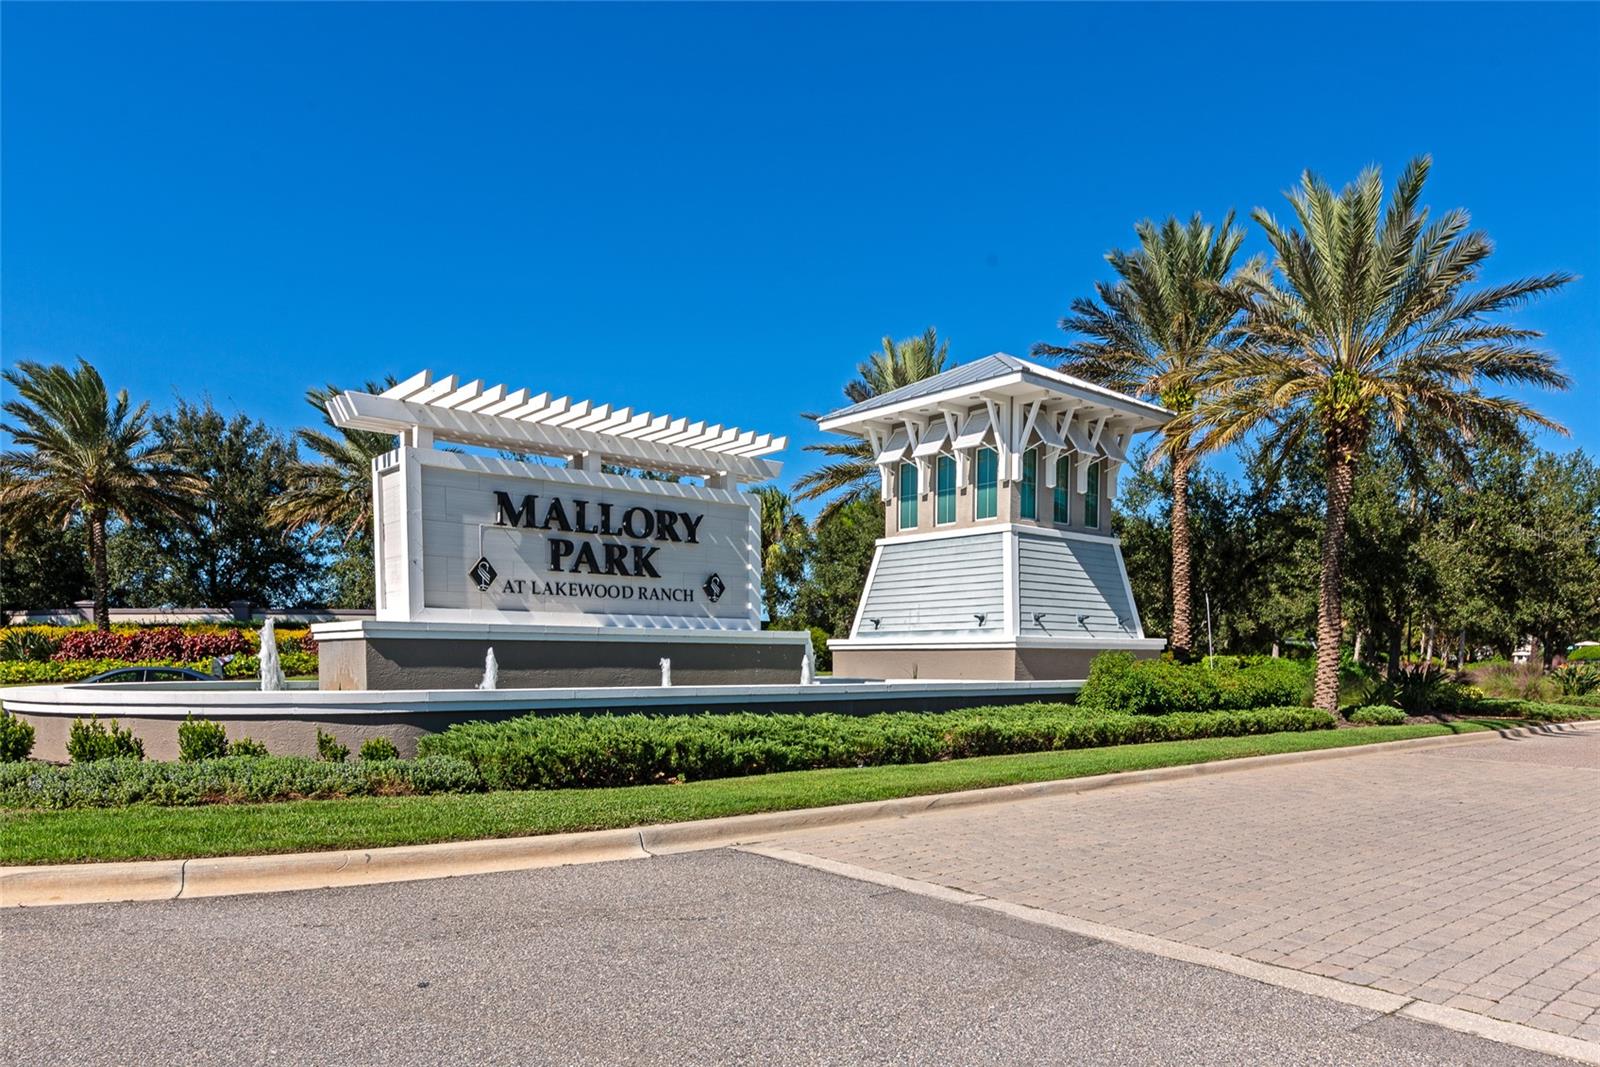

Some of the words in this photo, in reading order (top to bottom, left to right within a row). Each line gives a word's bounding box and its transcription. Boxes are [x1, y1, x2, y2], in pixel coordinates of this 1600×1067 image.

[493, 490, 704, 544] MALLORY
[547, 538, 661, 578] PARK
[502, 579, 526, 594] AT
[531, 580, 634, 600] LAKEWOOD
[638, 587, 695, 602] RANCH
